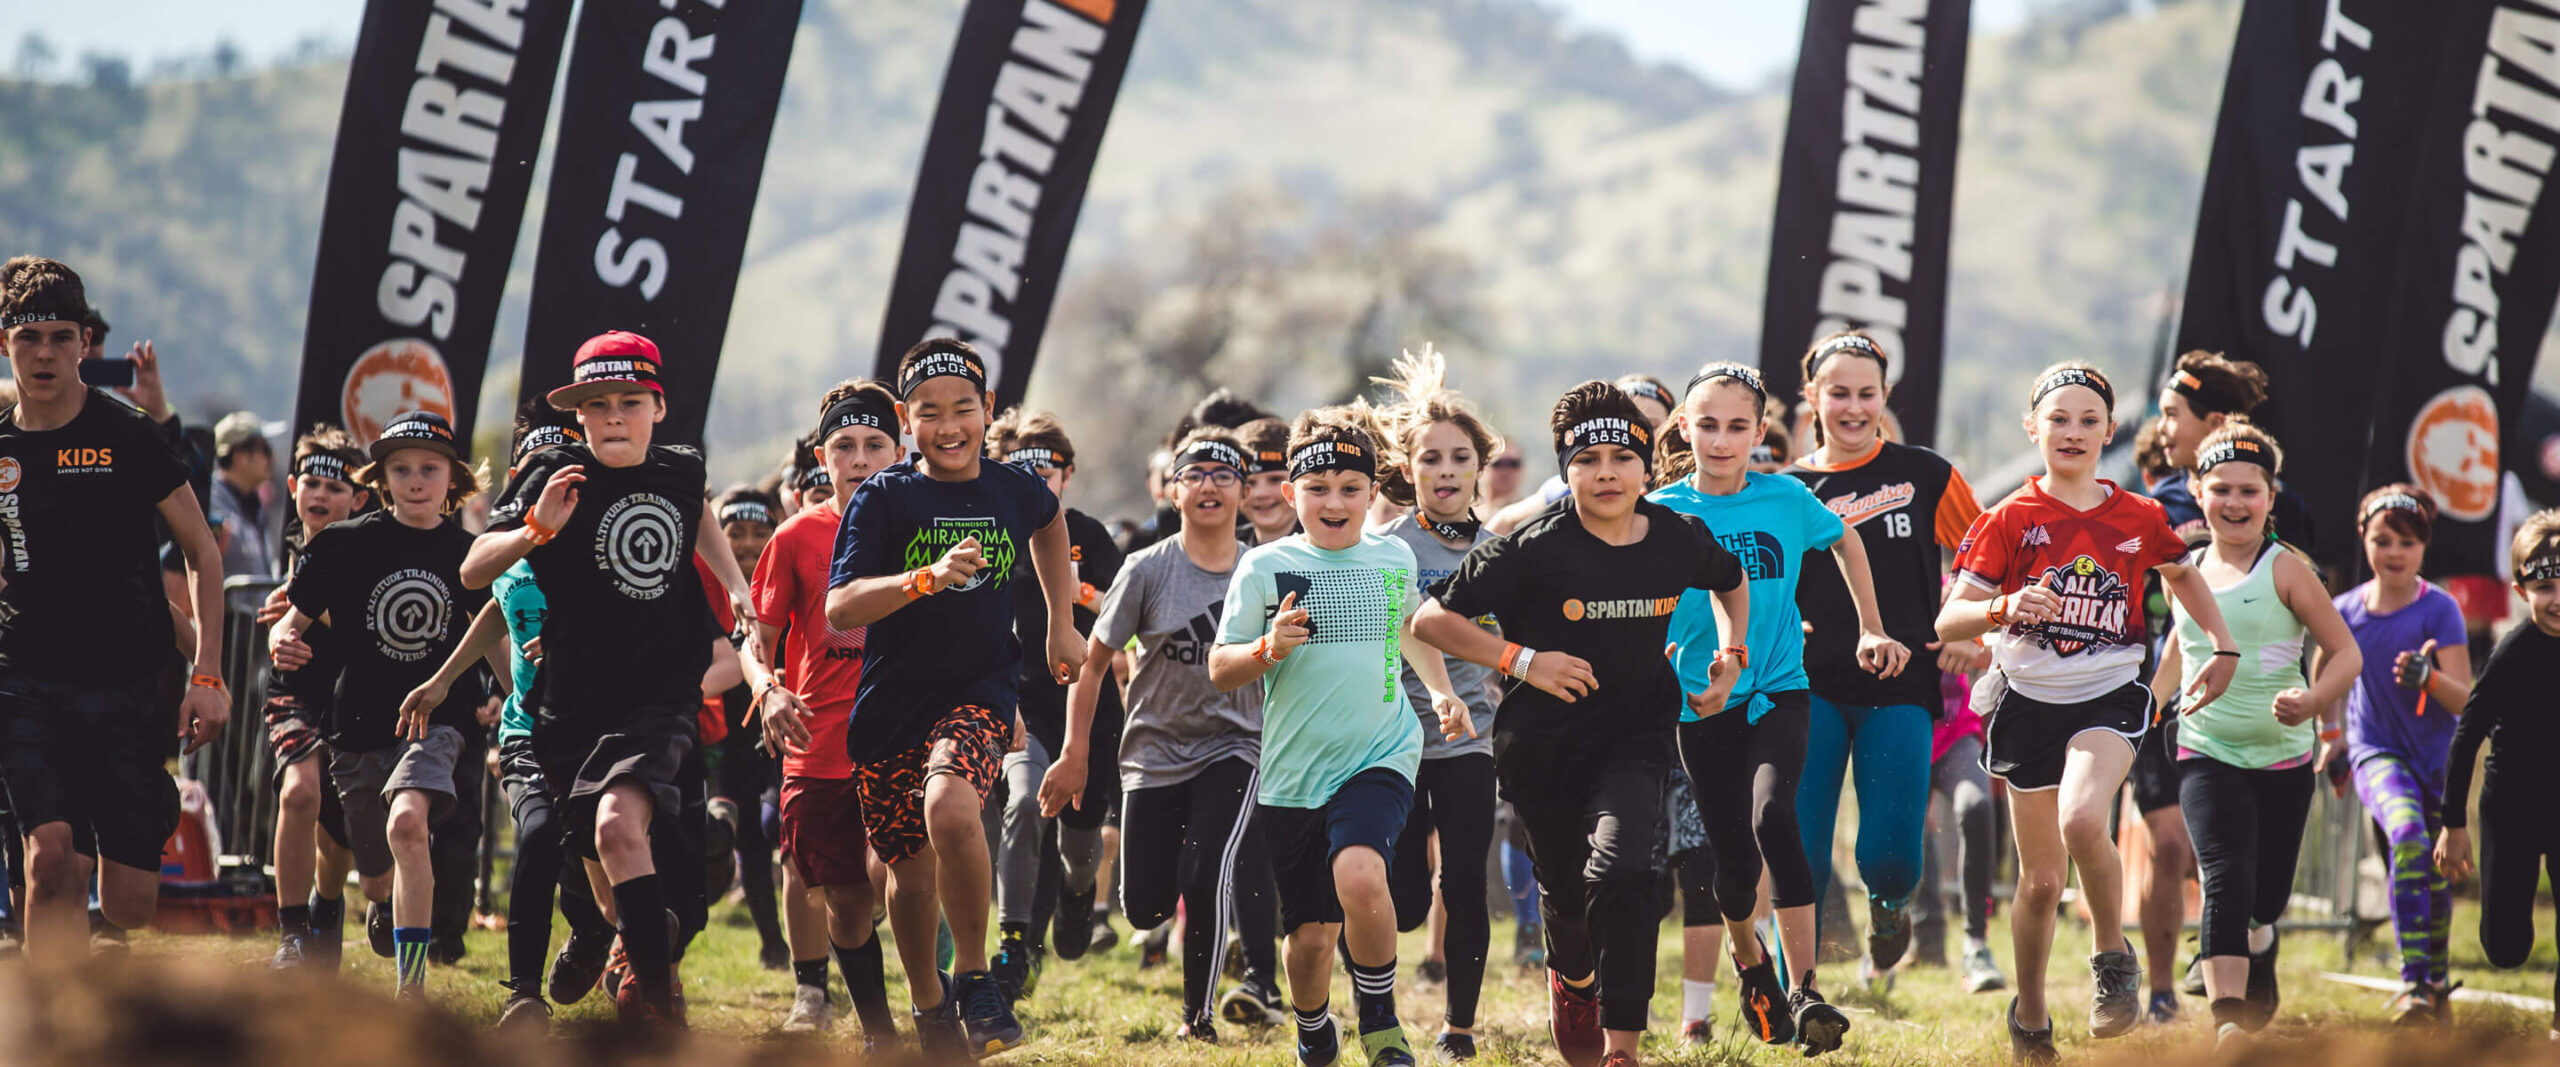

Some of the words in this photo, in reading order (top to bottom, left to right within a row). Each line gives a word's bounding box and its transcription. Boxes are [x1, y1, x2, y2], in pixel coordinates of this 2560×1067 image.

[594, 0, 726, 301] STAR
[914, 352, 964, 373] SPARTAN
[926, 362, 968, 377] 8602
[841, 414, 879, 428] 8633
[1573, 417, 1629, 438] SPARTAN
[1589, 429, 1630, 446] 8858
[57, 448, 112, 466] KIDS
[1293, 441, 1333, 464] SPARTAN
[1336, 442, 1361, 457] KIDS
[1300, 452, 1336, 473] 8581
[594, 497, 630, 552] ALTITUDE
[941, 520, 954, 528] SAN
[955, 520, 989, 528] FRANCISCO
[1883, 512, 1912, 538] 18
[1716, 531, 1755, 549] THE
[370, 570, 403, 613] ALTITUDE
[618, 584, 665, 600] MEYERS
[2064, 575, 2099, 597] ALL
[1378, 568, 1398, 703] ARMOUR
[379, 643, 428, 662] MEYERS
[1161, 640, 1209, 665] adi
